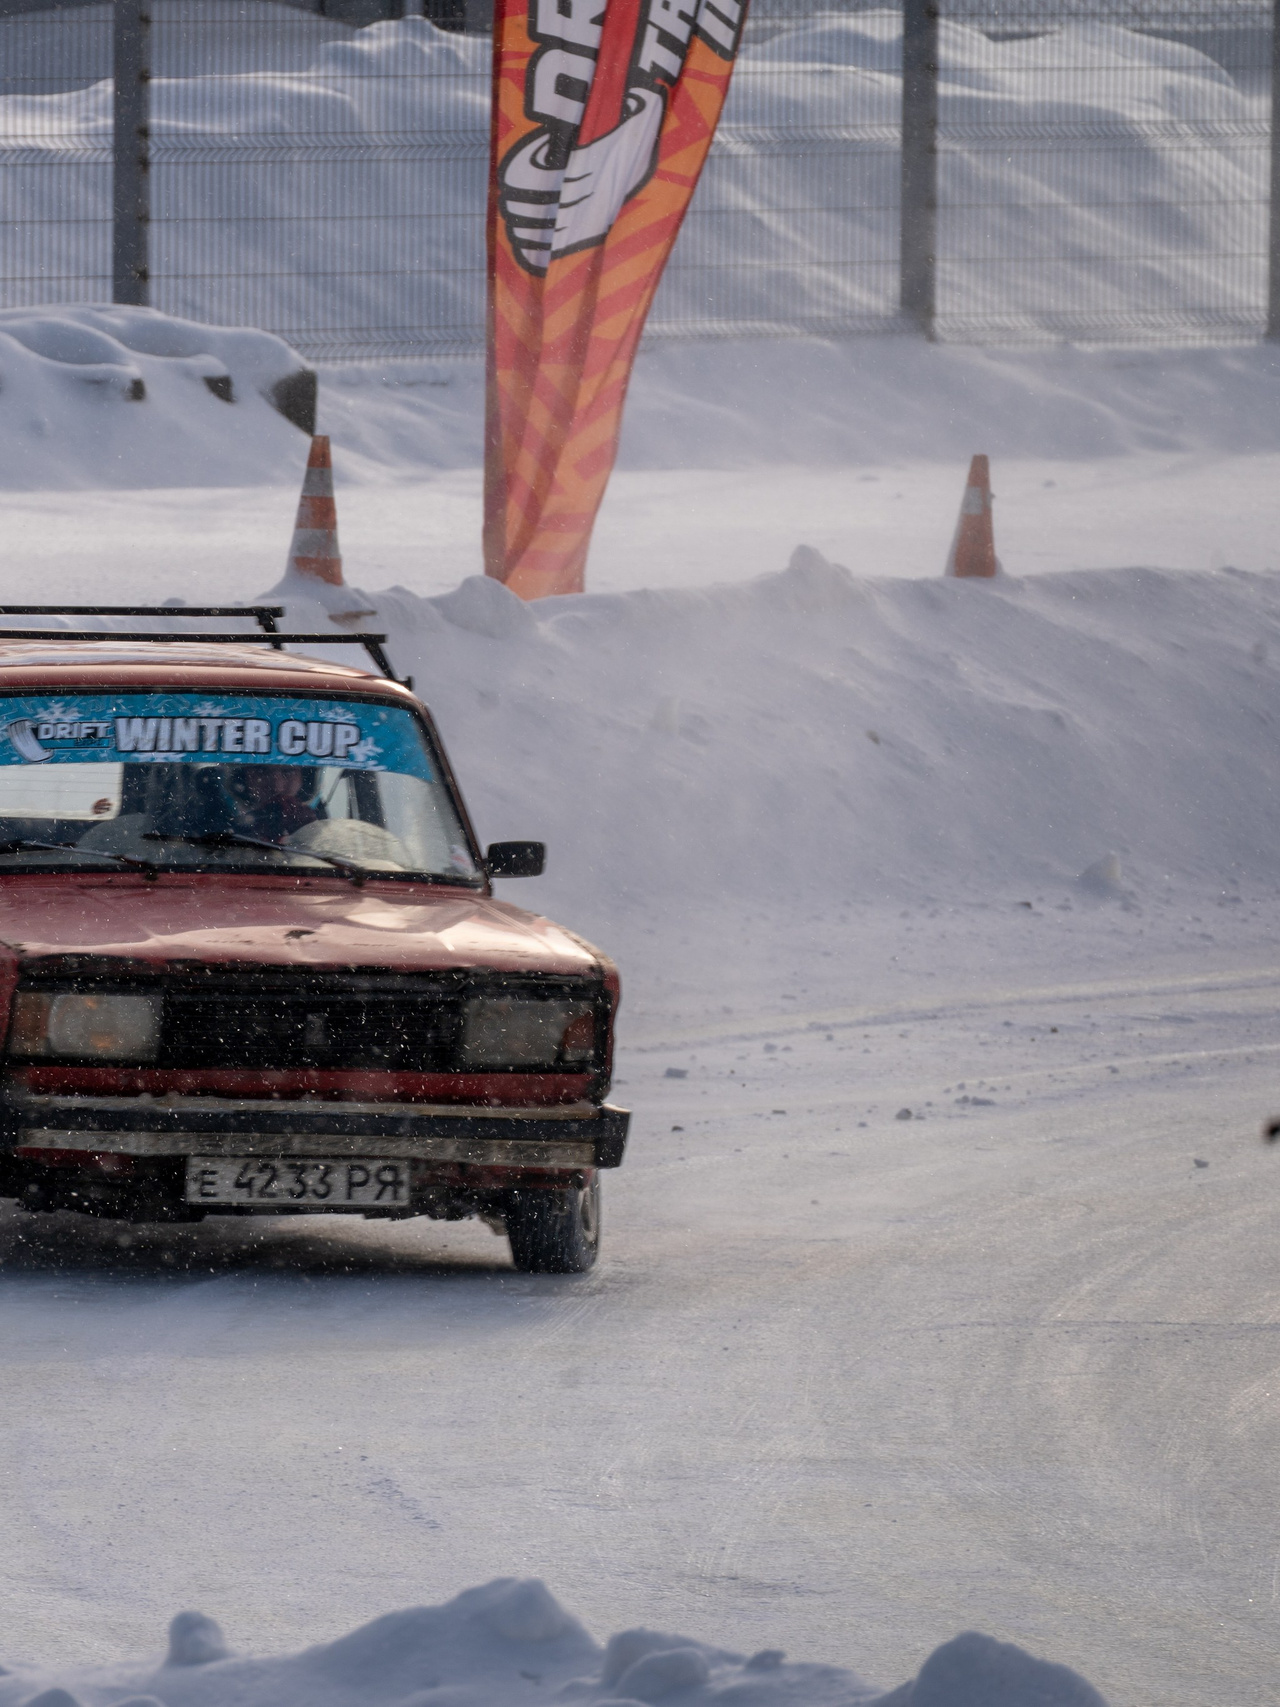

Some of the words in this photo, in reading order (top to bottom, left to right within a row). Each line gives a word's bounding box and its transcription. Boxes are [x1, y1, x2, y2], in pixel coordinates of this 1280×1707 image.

[38, 721, 111, 739] DRIFT
[114, 716, 270, 753] WINTER
[277, 719, 360, 758] CUP
[234, 1161, 331, 1199] 4233
